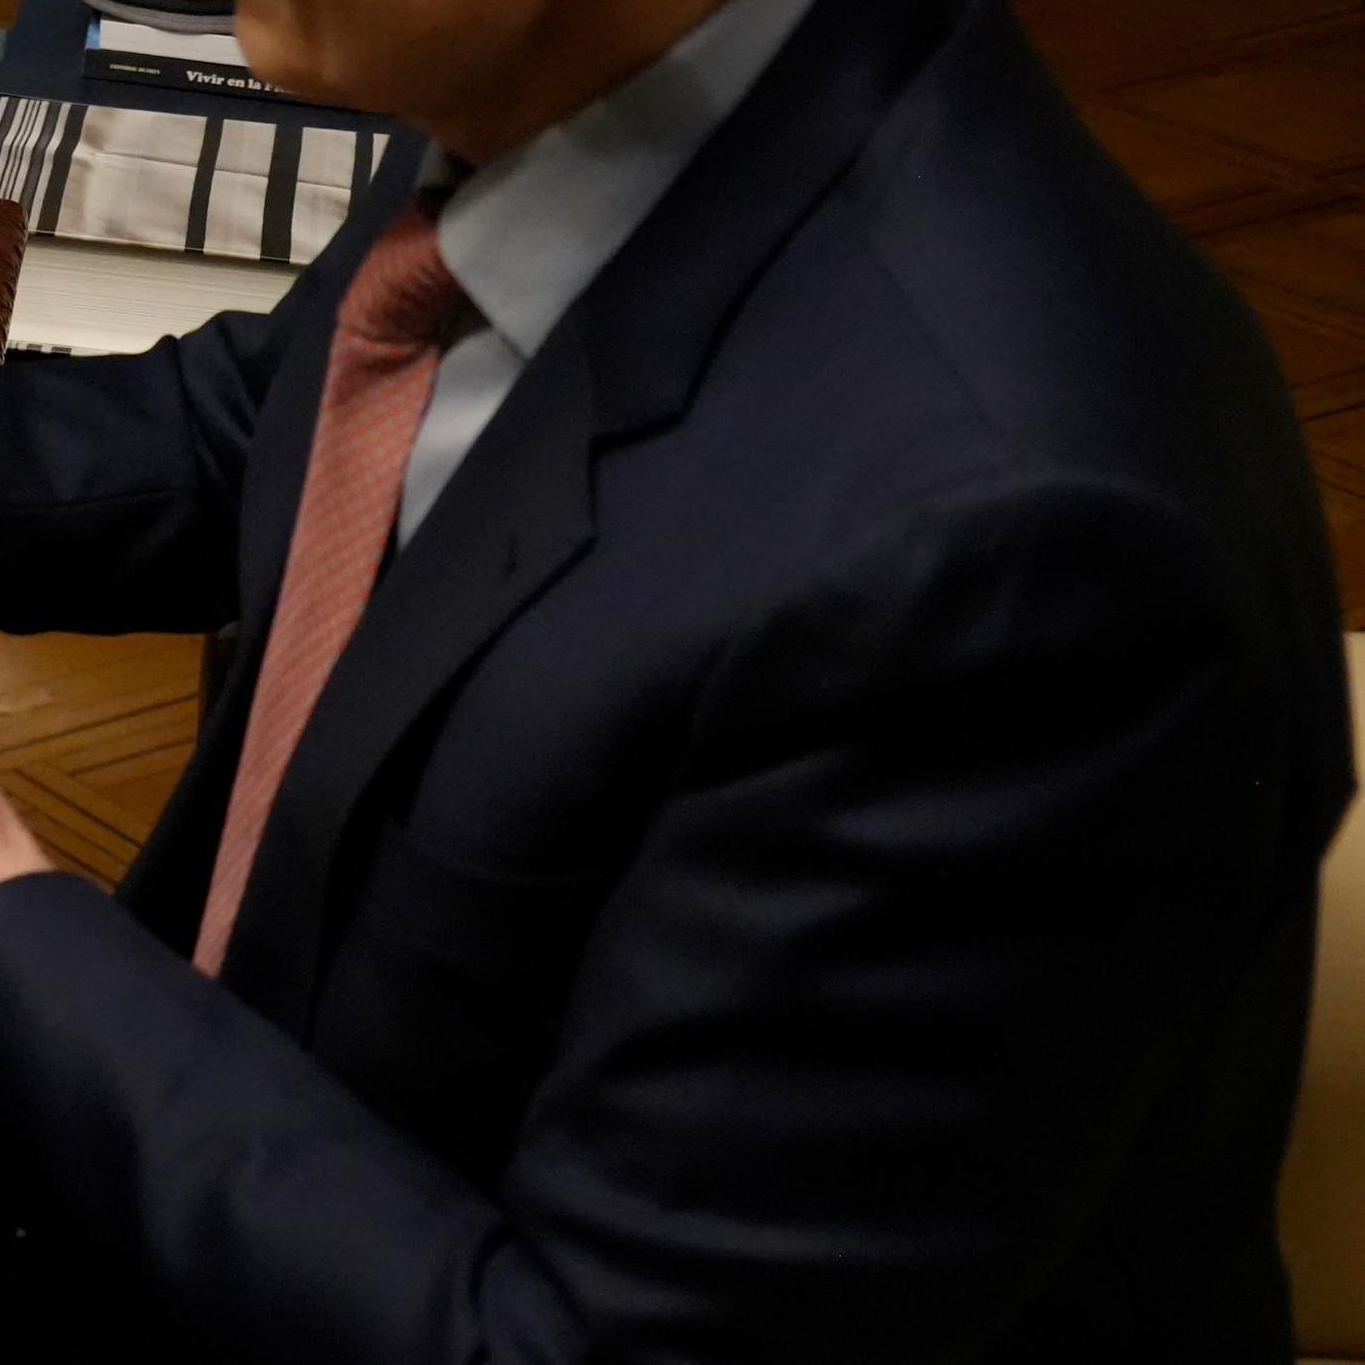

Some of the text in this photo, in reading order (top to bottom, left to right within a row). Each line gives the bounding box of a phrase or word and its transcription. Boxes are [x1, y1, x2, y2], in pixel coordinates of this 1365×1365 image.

[185, 70, 225, 86] Vivir
[226, 78, 245, 89] en
[247, 78, 263, 91] la
